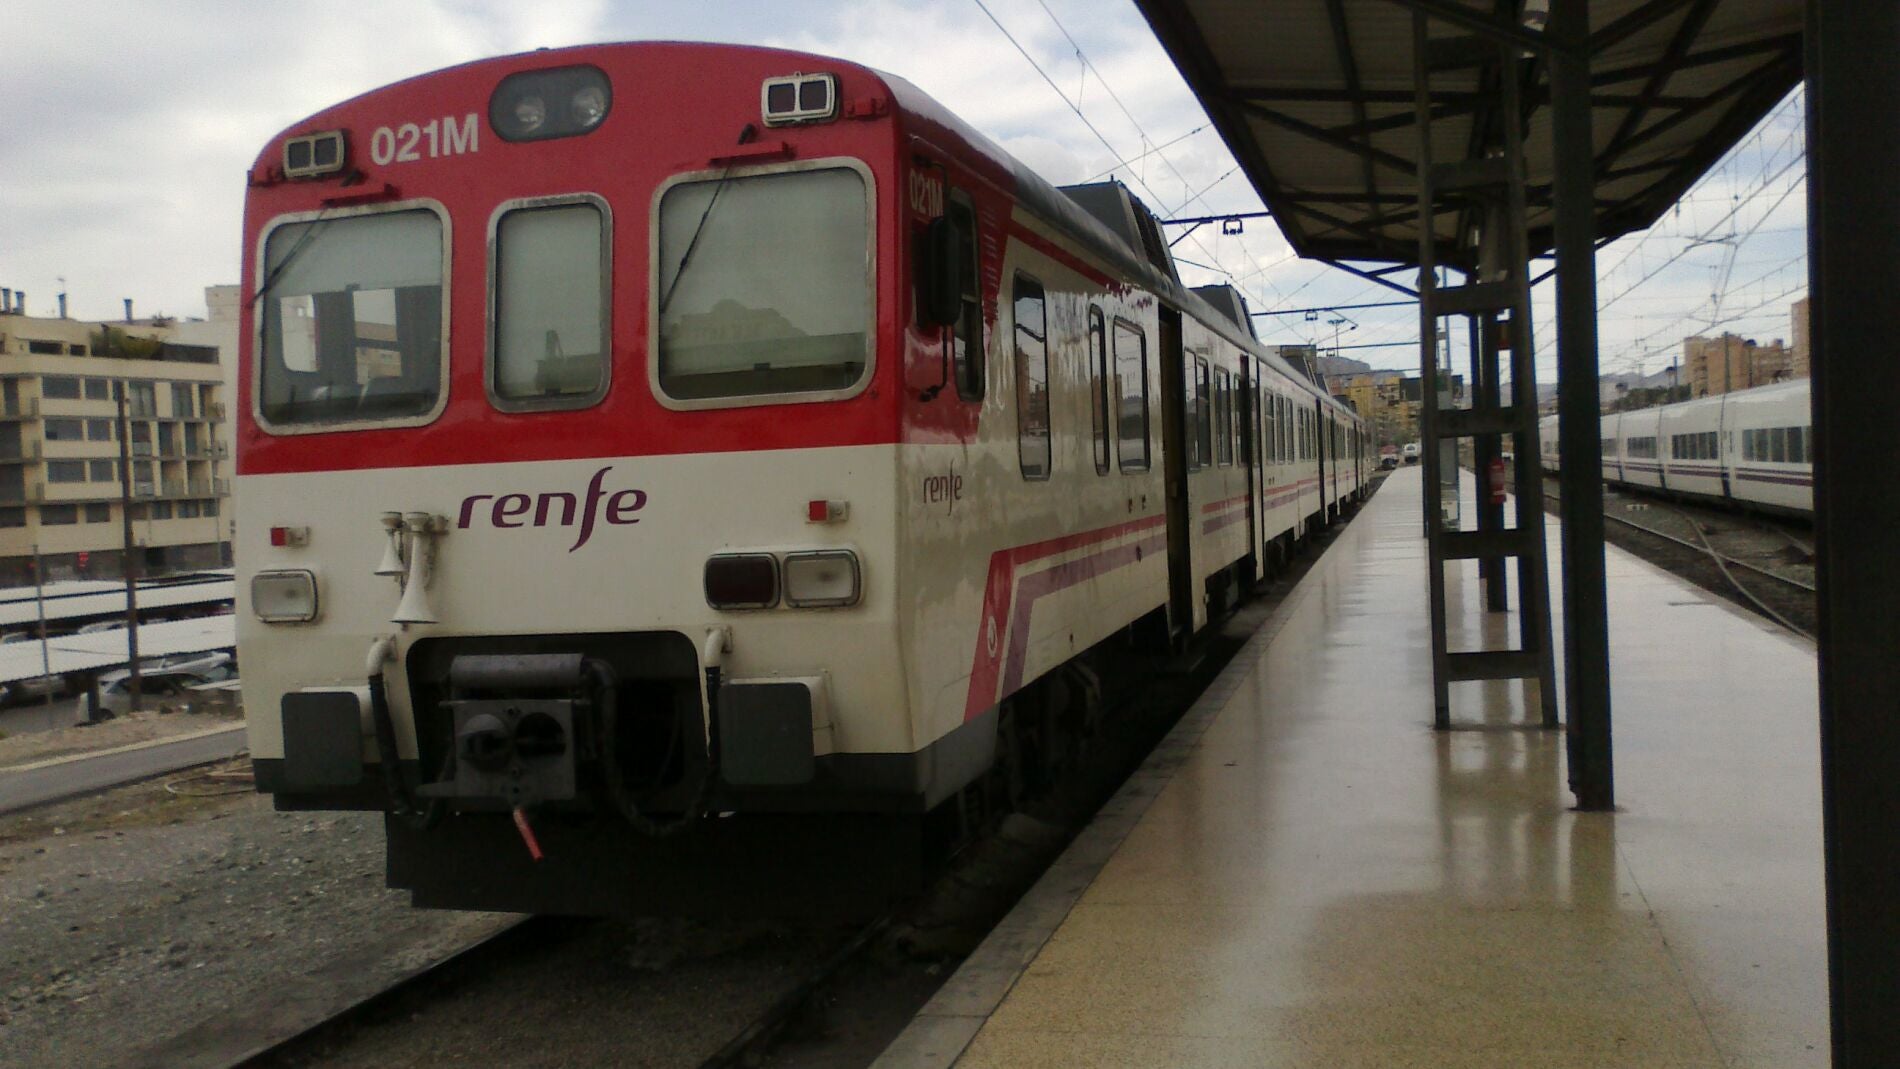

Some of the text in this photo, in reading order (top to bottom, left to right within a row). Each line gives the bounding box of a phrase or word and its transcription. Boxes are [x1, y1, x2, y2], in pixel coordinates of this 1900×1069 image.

[371, 113, 479, 166] 021M
[909, 169, 943, 217] 021M
[458, 466, 648, 553] renfe
[923, 458, 963, 516] renfe
